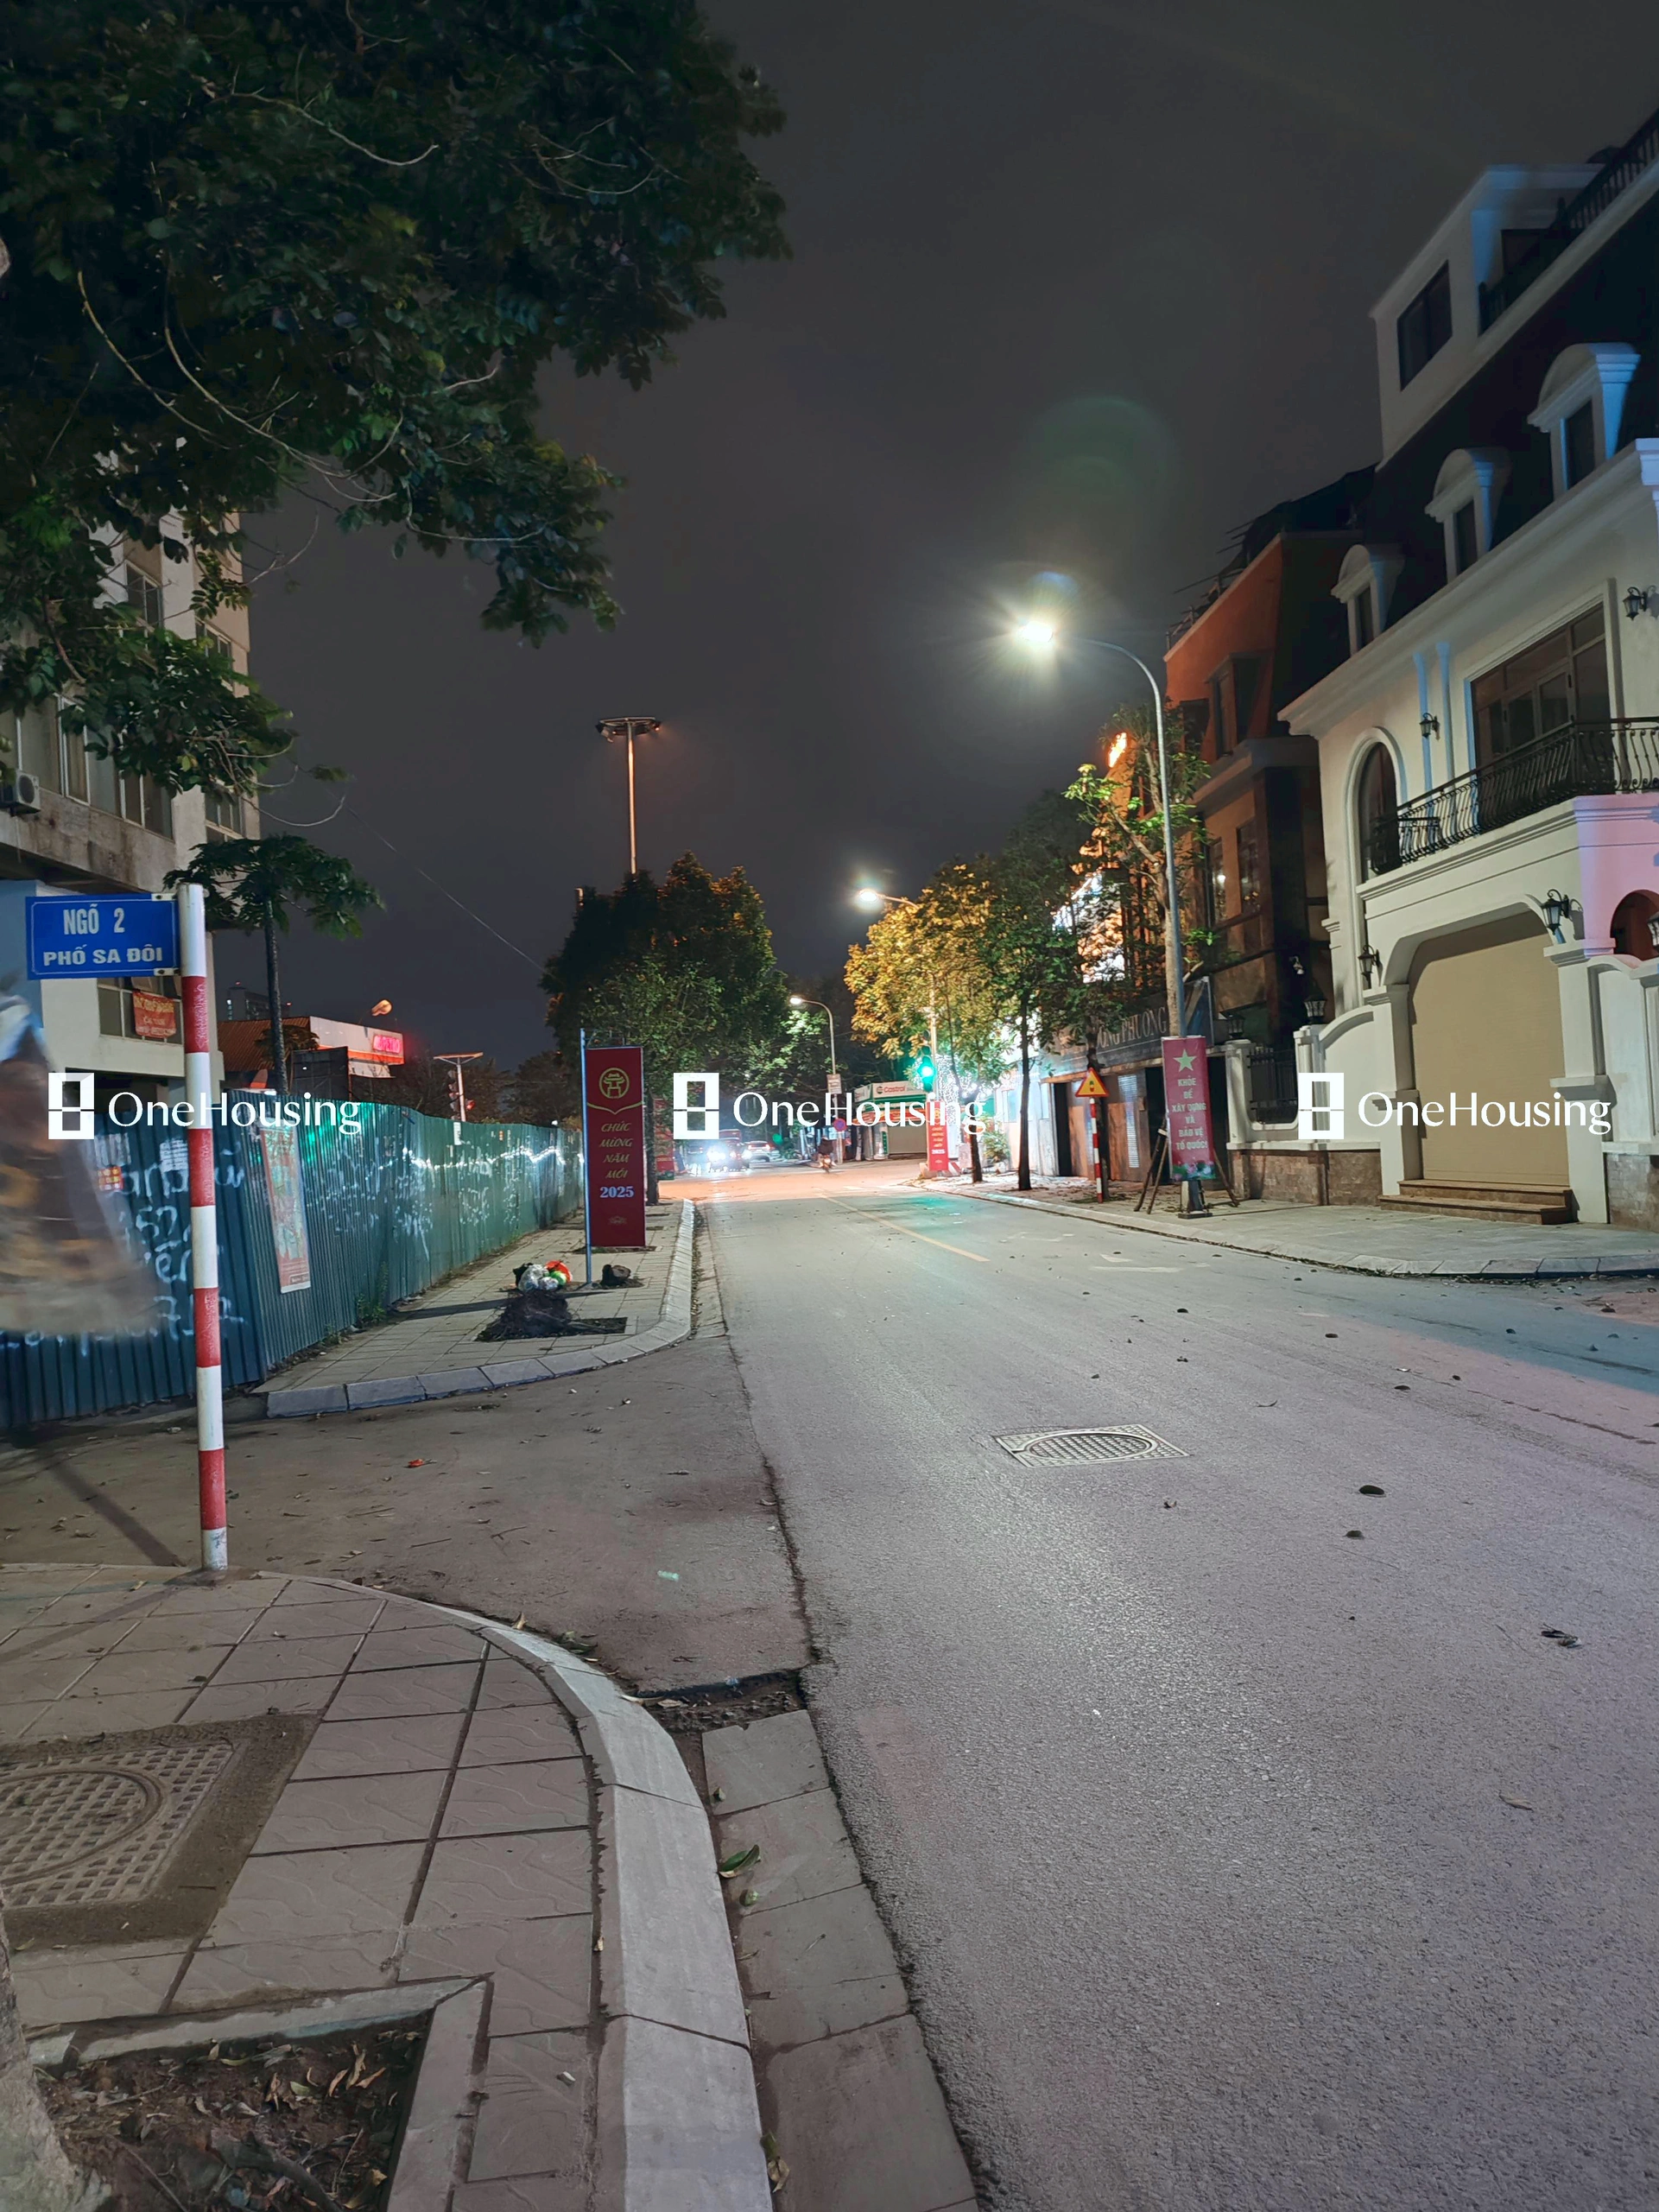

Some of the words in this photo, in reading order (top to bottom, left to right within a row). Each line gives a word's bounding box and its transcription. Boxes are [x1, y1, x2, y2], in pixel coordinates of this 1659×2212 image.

[63, 903, 100, 935] NGÕ
[113, 908, 125, 934] 2
[43, 944, 87, 967] PHỐ
[92, 949, 121, 965] SA
[127, 943, 163, 963] ĐÔI
[883, 1085, 906, 1094] Castrol
[601, 1120, 631, 1132] CHÚC
[603, 1152, 630, 1163] NĂM
[599, 1185, 635, 1199] 2025
